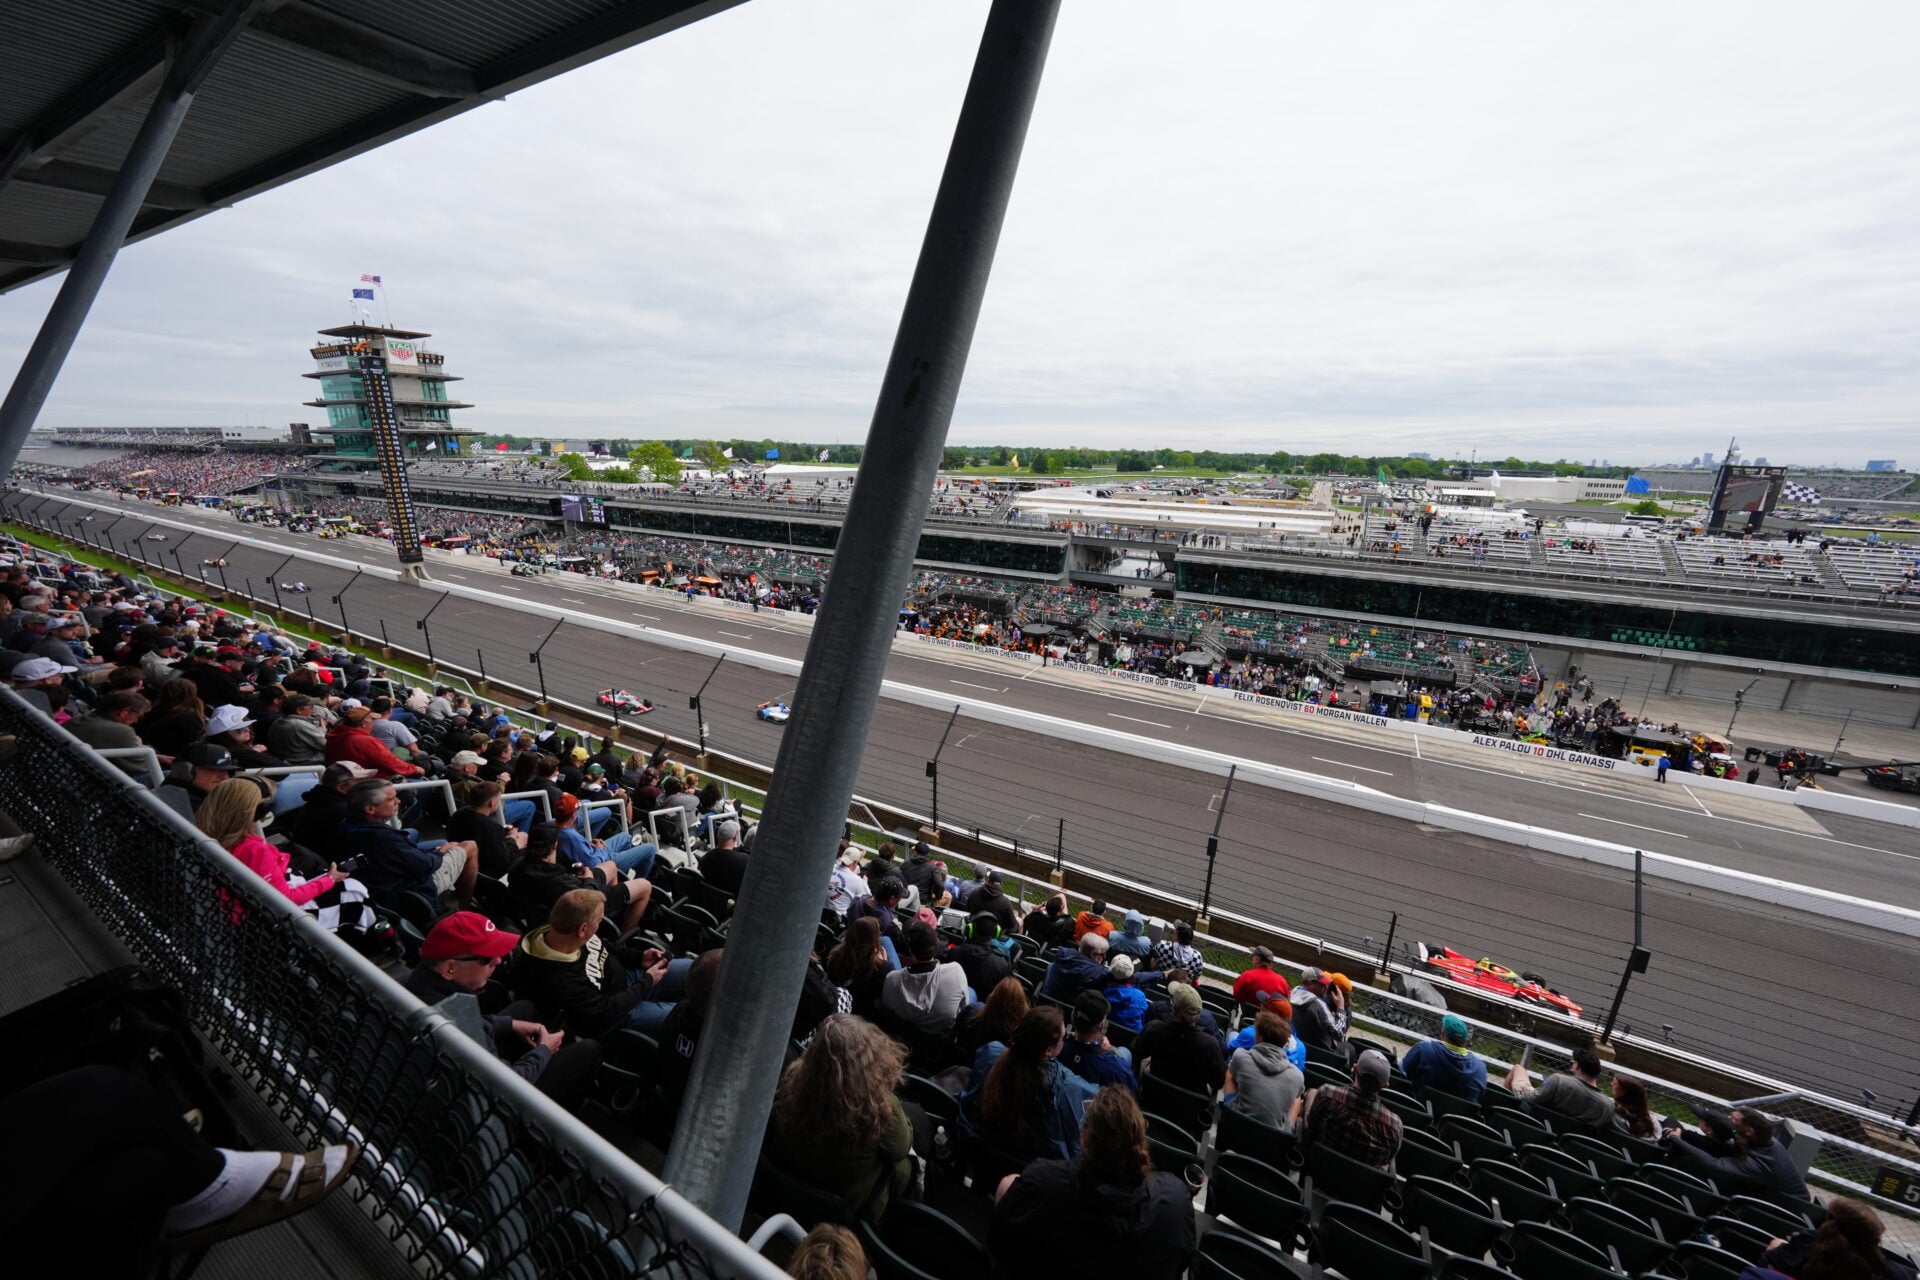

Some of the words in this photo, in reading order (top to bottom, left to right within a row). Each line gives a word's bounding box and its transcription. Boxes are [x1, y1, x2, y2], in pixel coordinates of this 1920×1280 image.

[390, 342, 411, 350] TAG
[956, 642, 974, 651] ARROW
[974, 645, 999, 656] MCLAREN
[1000, 650, 1031, 661] CHEVROLET
[1052, 658, 1078, 671] SANTINO
[1079, 664, 1108, 676] FERRUCCI
[1117, 671, 1140, 682] HOMES
[1141, 675, 1154, 684] FOR
[1155, 678, 1168, 687] OUR
[1170, 680, 1196, 692] TROOPS
[1234, 691, 1254, 703] FELIX
[1256, 694, 1303, 712] ROSENQVIST
[1304, 705, 1314, 714] 60
[1316, 707, 1351, 721] MORGAN
[1352, 714, 1388, 728] WALLEN
[1472, 736, 1498, 748] ALEX
[1499, 740, 1531, 754] PALOU
[1533, 746, 1544, 757] 10
[1546, 749, 1566, 761] DHL
[1568, 753, 1616, 770] GANASSI
[1880, 1176, 1899, 1196] BOX
